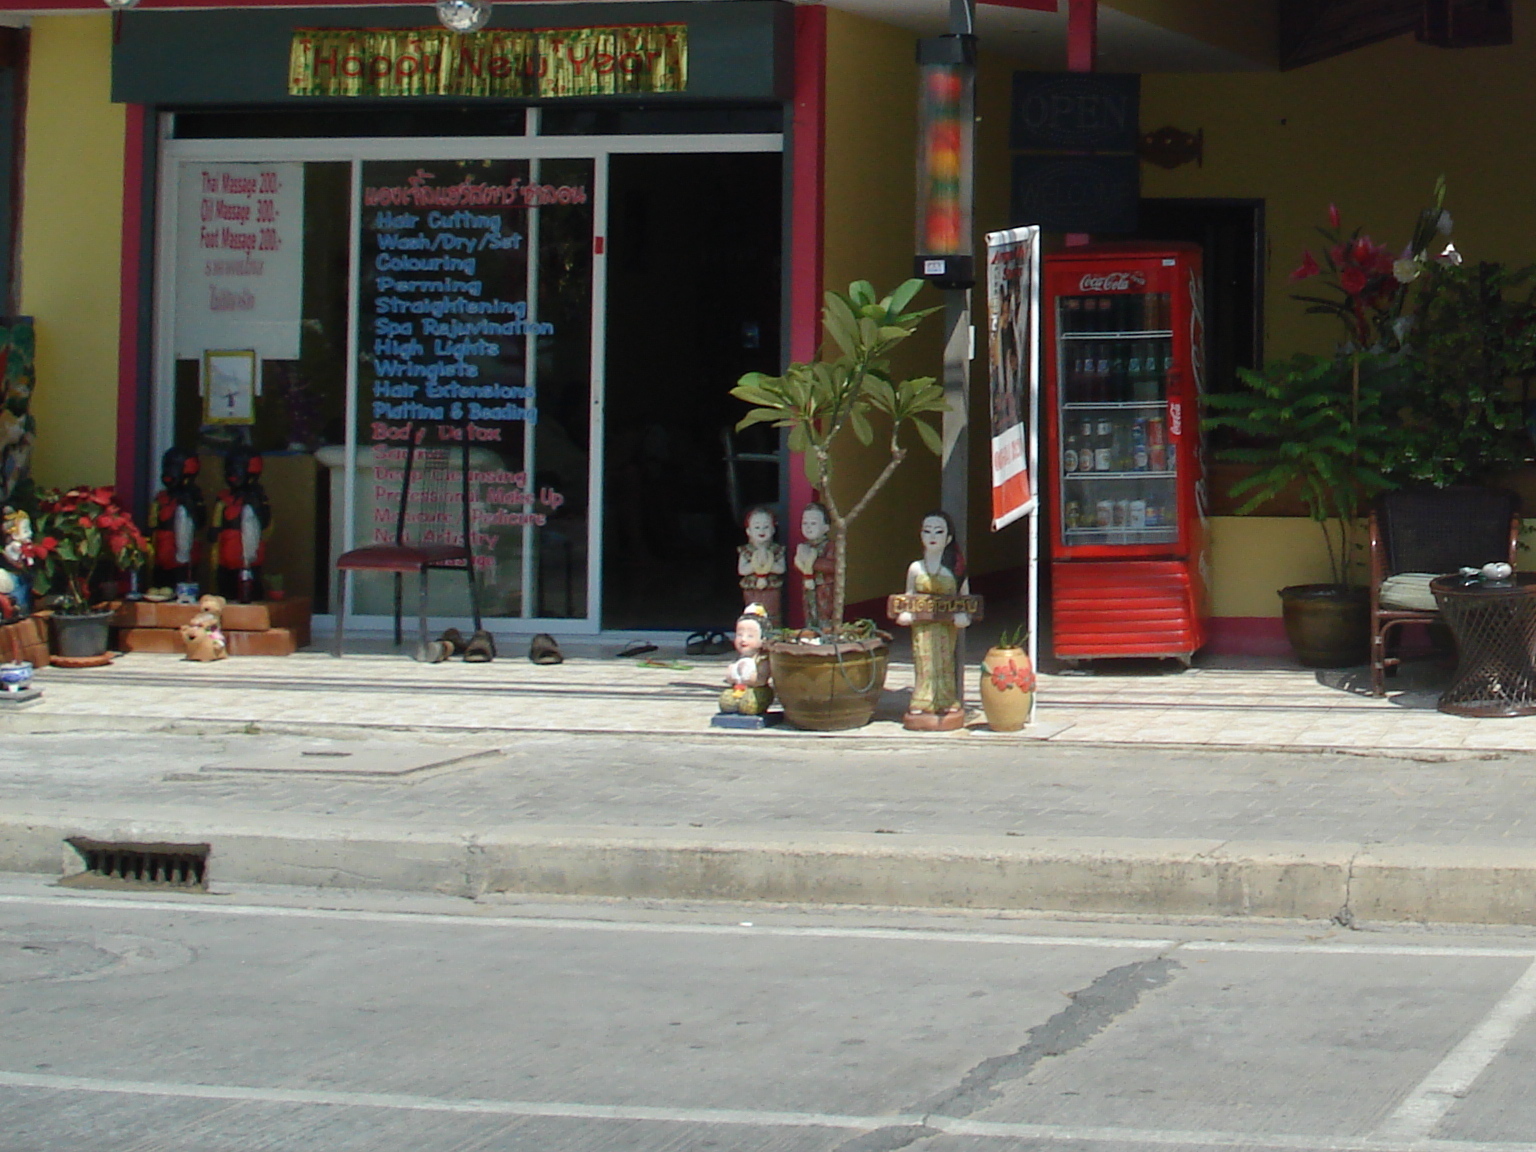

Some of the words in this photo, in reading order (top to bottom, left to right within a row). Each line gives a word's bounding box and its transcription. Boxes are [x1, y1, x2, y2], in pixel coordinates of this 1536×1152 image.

[313, 43, 442, 87] Happy
[458, 44, 547, 77] New
[1022, 94, 1127, 129] OPEN
[222, 172, 257, 199] Massage
[216, 200, 250, 226] Massage
[375, 211, 420, 229] Hair
[427, 211, 502, 234] Cutting
[201, 225, 219, 249] Foot
[222, 226, 257, 255] Massage
[375, 253, 476, 276] Colouring
[376, 276, 482, 296] Perming
[1079, 272, 1130, 291] Coca-Cola
[375, 297, 527, 319] Straightening
[374, 318, 413, 338] Spa
[421, 319, 554, 339] Rejuvination
[374, 338, 424, 360] High
[434, 338, 500, 362] Lights
[374, 360, 479, 381] Wringlets
[373, 380, 419, 398] Hair
[426, 381, 536, 399] Extensions
[468, 402, 538, 424] Beading
[487, 487, 535, 505] Make
[540, 487, 565, 510] Up
[470, 509, 547, 526] Pedicure
